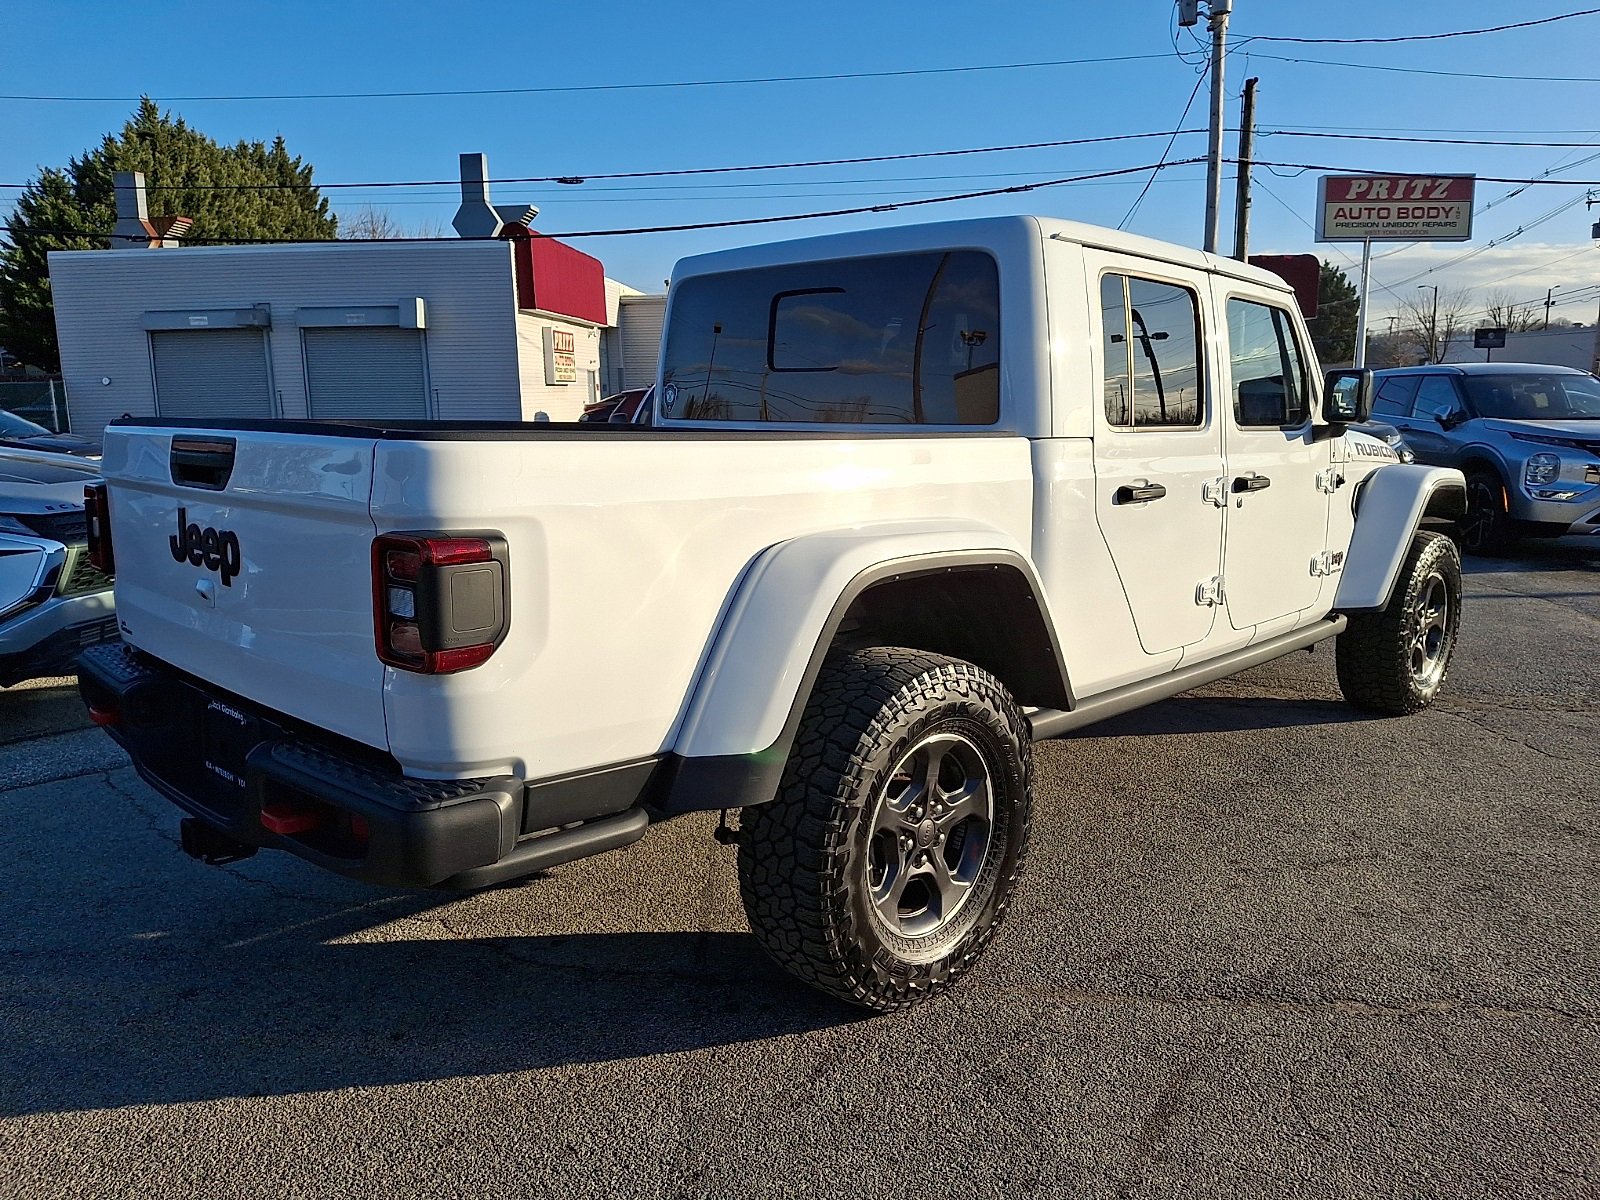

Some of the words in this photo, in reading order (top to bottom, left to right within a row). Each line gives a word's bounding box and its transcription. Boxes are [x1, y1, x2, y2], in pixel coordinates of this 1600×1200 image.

[1345, 179, 1453, 200] PRITZ
[1333, 207, 1391, 219] AUTO
[1397, 206, 1454, 219] BODY
[554, 332, 573, 351] PRITZ
[169, 507, 240, 587] Jeep
